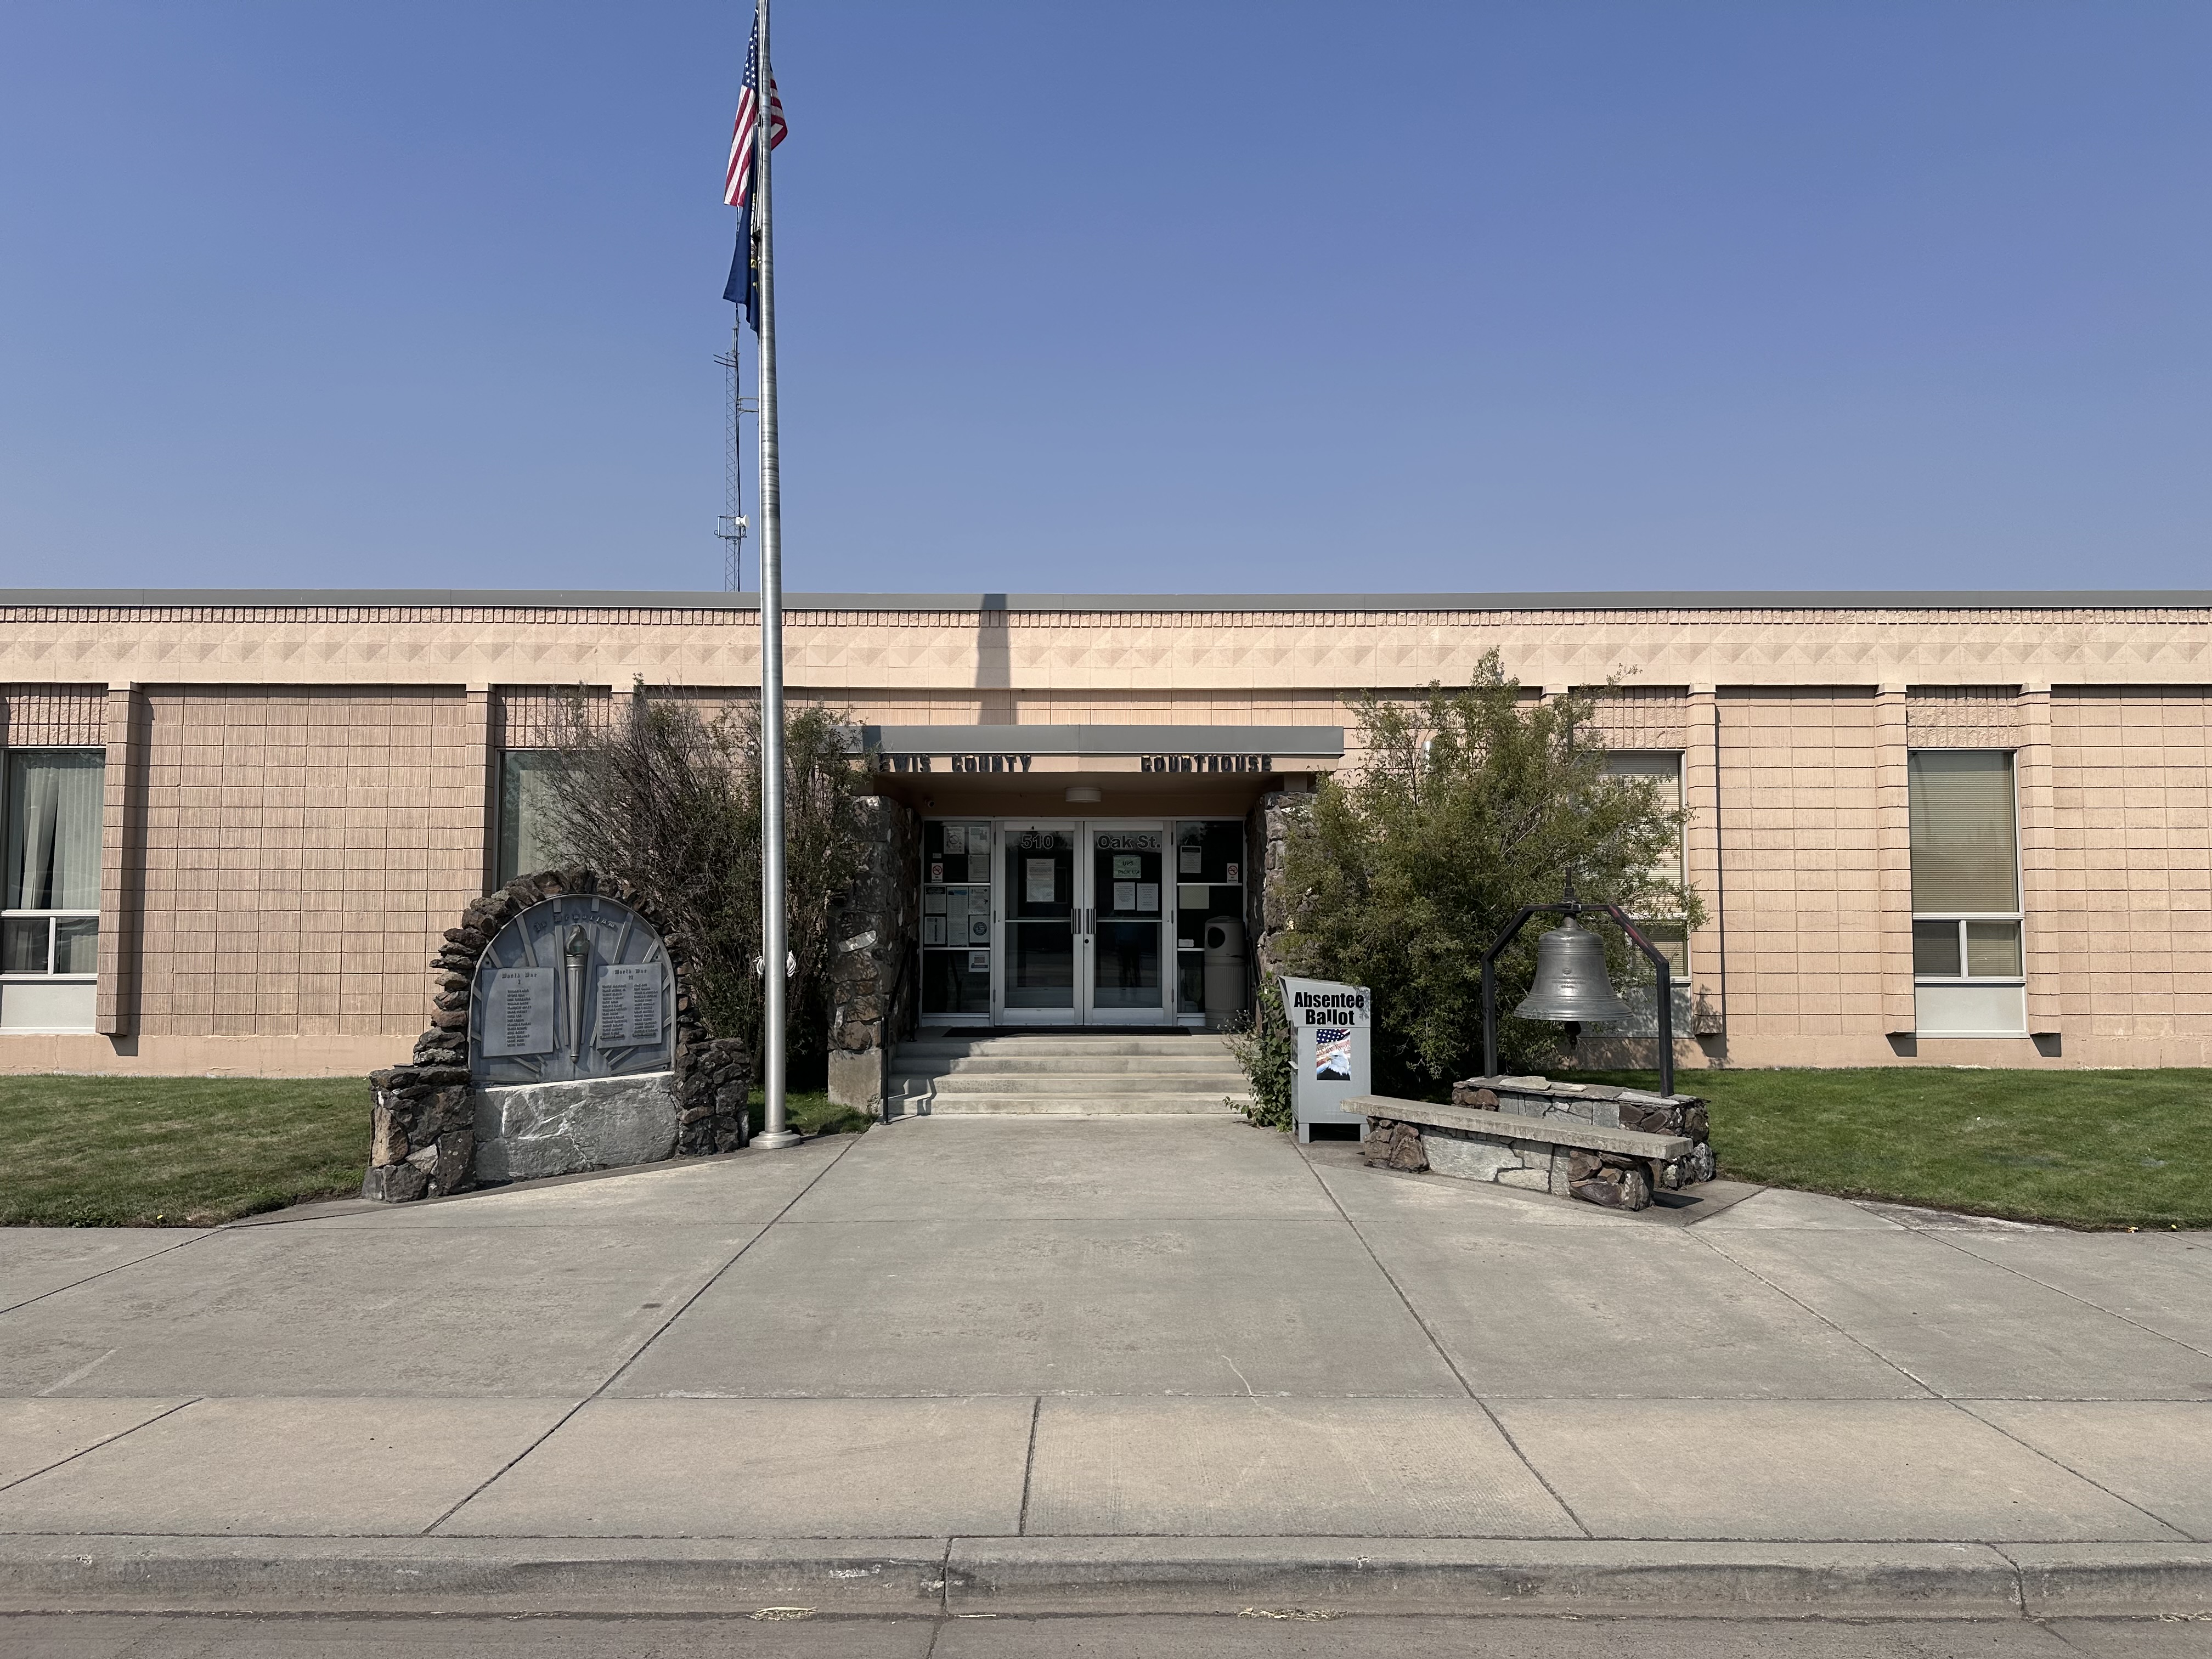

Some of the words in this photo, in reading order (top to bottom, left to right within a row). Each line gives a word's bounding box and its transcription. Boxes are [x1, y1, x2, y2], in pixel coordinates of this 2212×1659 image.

[867, 754, 931, 772] EWIS
[952, 754, 1031, 772] COUNTY
[1141, 754, 1272, 772] COURTHOUSE
[1020, 834, 1054, 849] 510
[1097, 834, 1133, 849] Oak
[1137, 834, 1162, 849] St.
[1294, 991, 1365, 1008] Absentee
[1305, 1009, 1356, 1025] Ballot
